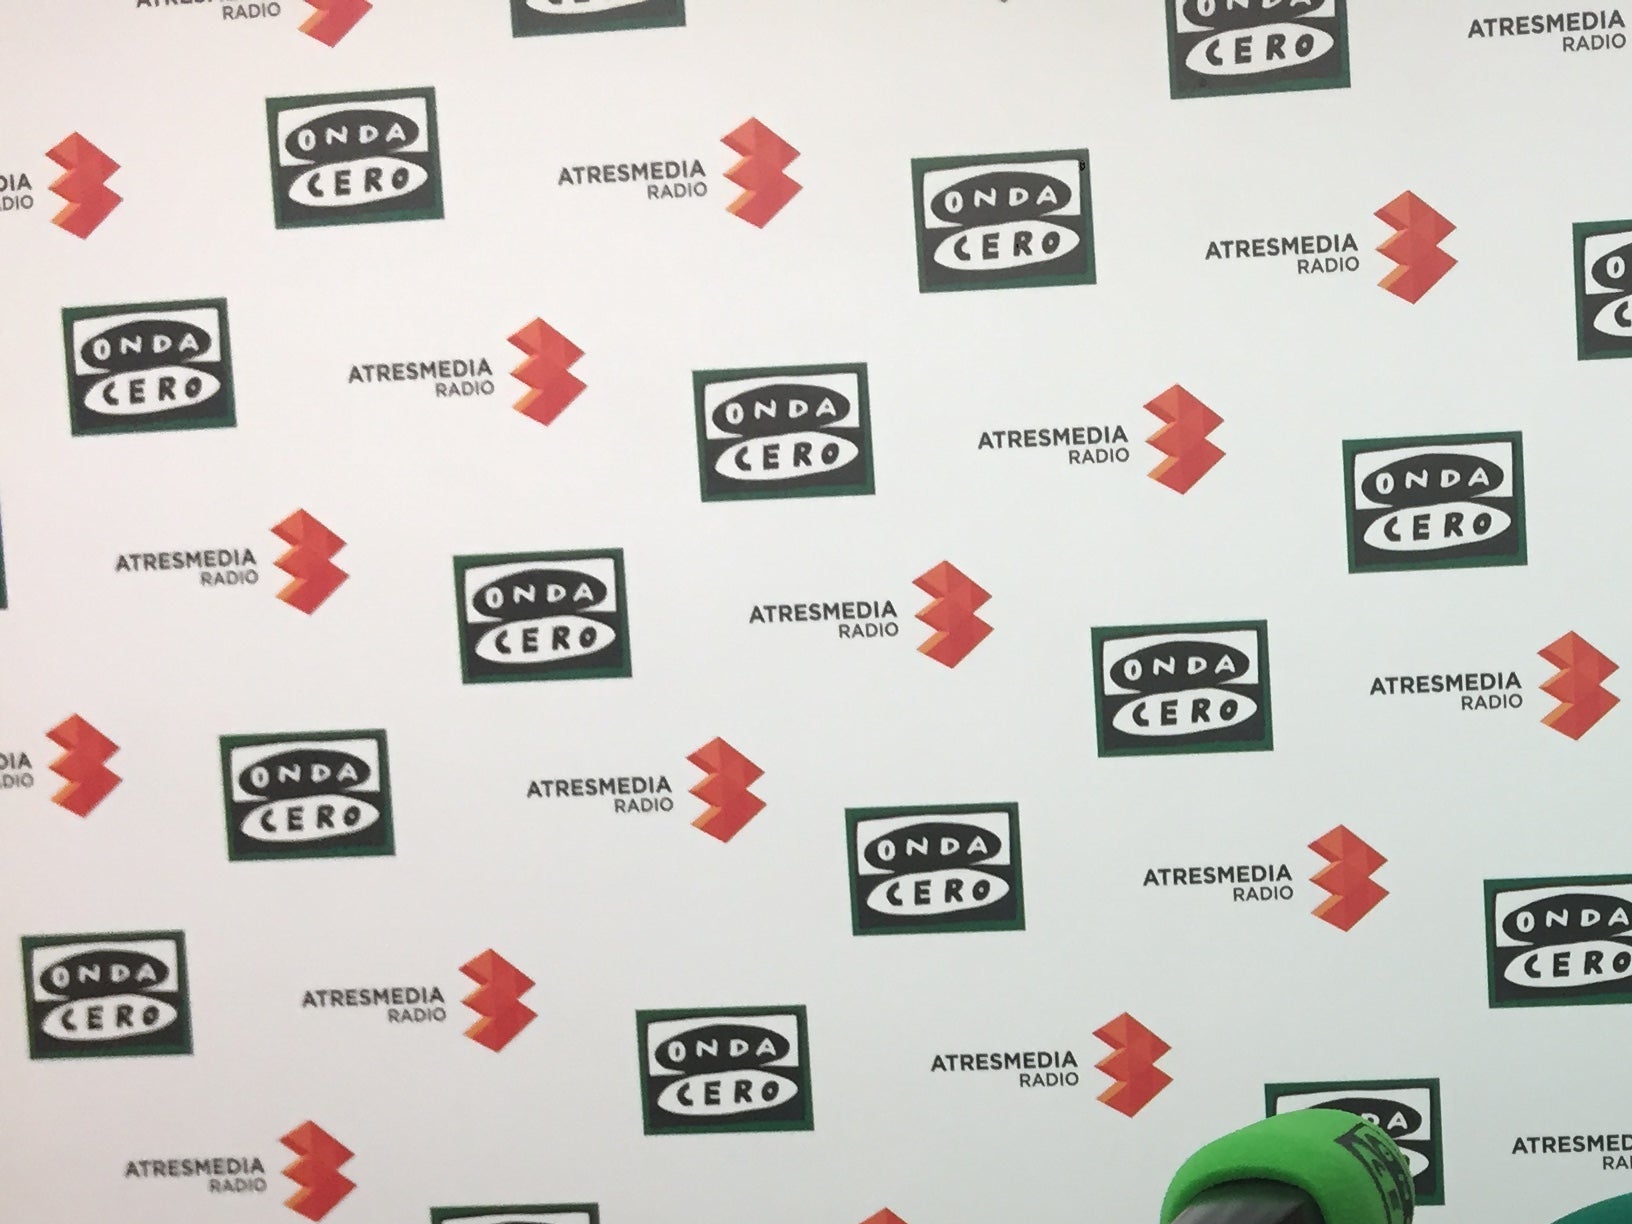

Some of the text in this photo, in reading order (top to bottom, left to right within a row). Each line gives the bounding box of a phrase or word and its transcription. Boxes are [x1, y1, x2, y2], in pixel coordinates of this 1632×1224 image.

[222, 2, 281, 20] RADIO
[1468, 10, 1625, 38] ATRESMEDIA
[1206, 34, 1313, 65] CERO
[1563, 33, 1626, 52] RADIO
[298, 123, 406, 151] ONDA
[308, 168, 408, 196] CERO
[558, 159, 706, 186] ATRESMEDIA
[2, 195, 33, 211] DIO
[647, 182, 707, 200] RADIO
[945, 185, 1057, 213] ONDA
[954, 231, 1060, 260] CERO
[1205, 233, 1358, 260] ATRESMEDIA
[1297, 256, 1359, 274] RADIO
[93, 333, 199, 360] ONDA
[348, 358, 493, 383] ATRESMEDIA
[103, 377, 201, 405] CERO
[435, 380, 494, 397] RADIO
[726, 398, 836, 424] ONDA
[978, 425, 1128, 449] ATRESMEDIA
[735, 443, 839, 470] CERO
[1069, 447, 1129, 464] RADIO
[1376, 467, 1489, 494] ONDA
[1384, 512, 1491, 541] CERO
[115, 548, 256, 572] ATRESMEDIA
[201, 569, 258, 586] RADIO
[485, 583, 593, 608] ONDA
[749, 600, 898, 624] ATRESMEDIA
[496, 626, 596, 653] CERO
[839, 622, 899, 639] RADIO
[1124, 655, 1235, 680] ONDA
[1370, 672, 1522, 695] ATRESMEDIA
[1133, 699, 1237, 726] CERO
[1461, 694, 1523, 710] RADIO
[2, 773, 34, 788] DIO
[251, 763, 357, 788] ONDA
[527, 776, 672, 798] ATRESMEDIA
[614, 797, 673, 813] RADIO
[261, 805, 360, 832] CERO
[878, 836, 987, 861] ONDA
[1143, 864, 1292, 886] ATRESMEDIA
[887, 879, 990, 906] CERO
[1233, 885, 1293, 902] RADIO
[1517, 908, 1629, 932] ONDA
[52, 964, 156, 987] ONDA
[1525, 951, 1631, 978] CERO
[302, 987, 445, 1008] ATRESMEDIA
[62, 1005, 159, 1030] CERO
[388, 1007, 446, 1023] RADIO
[668, 1038, 776, 1062] ONDA
[931, 1051, 1078, 1072] ATRESMEDIA
[1019, 1072, 1079, 1087] RADIO
[677, 1080, 779, 1106] CERO
[124, 1157, 265, 1178] ATRESMEDIA
[209, 1177, 267, 1193] RADIO
